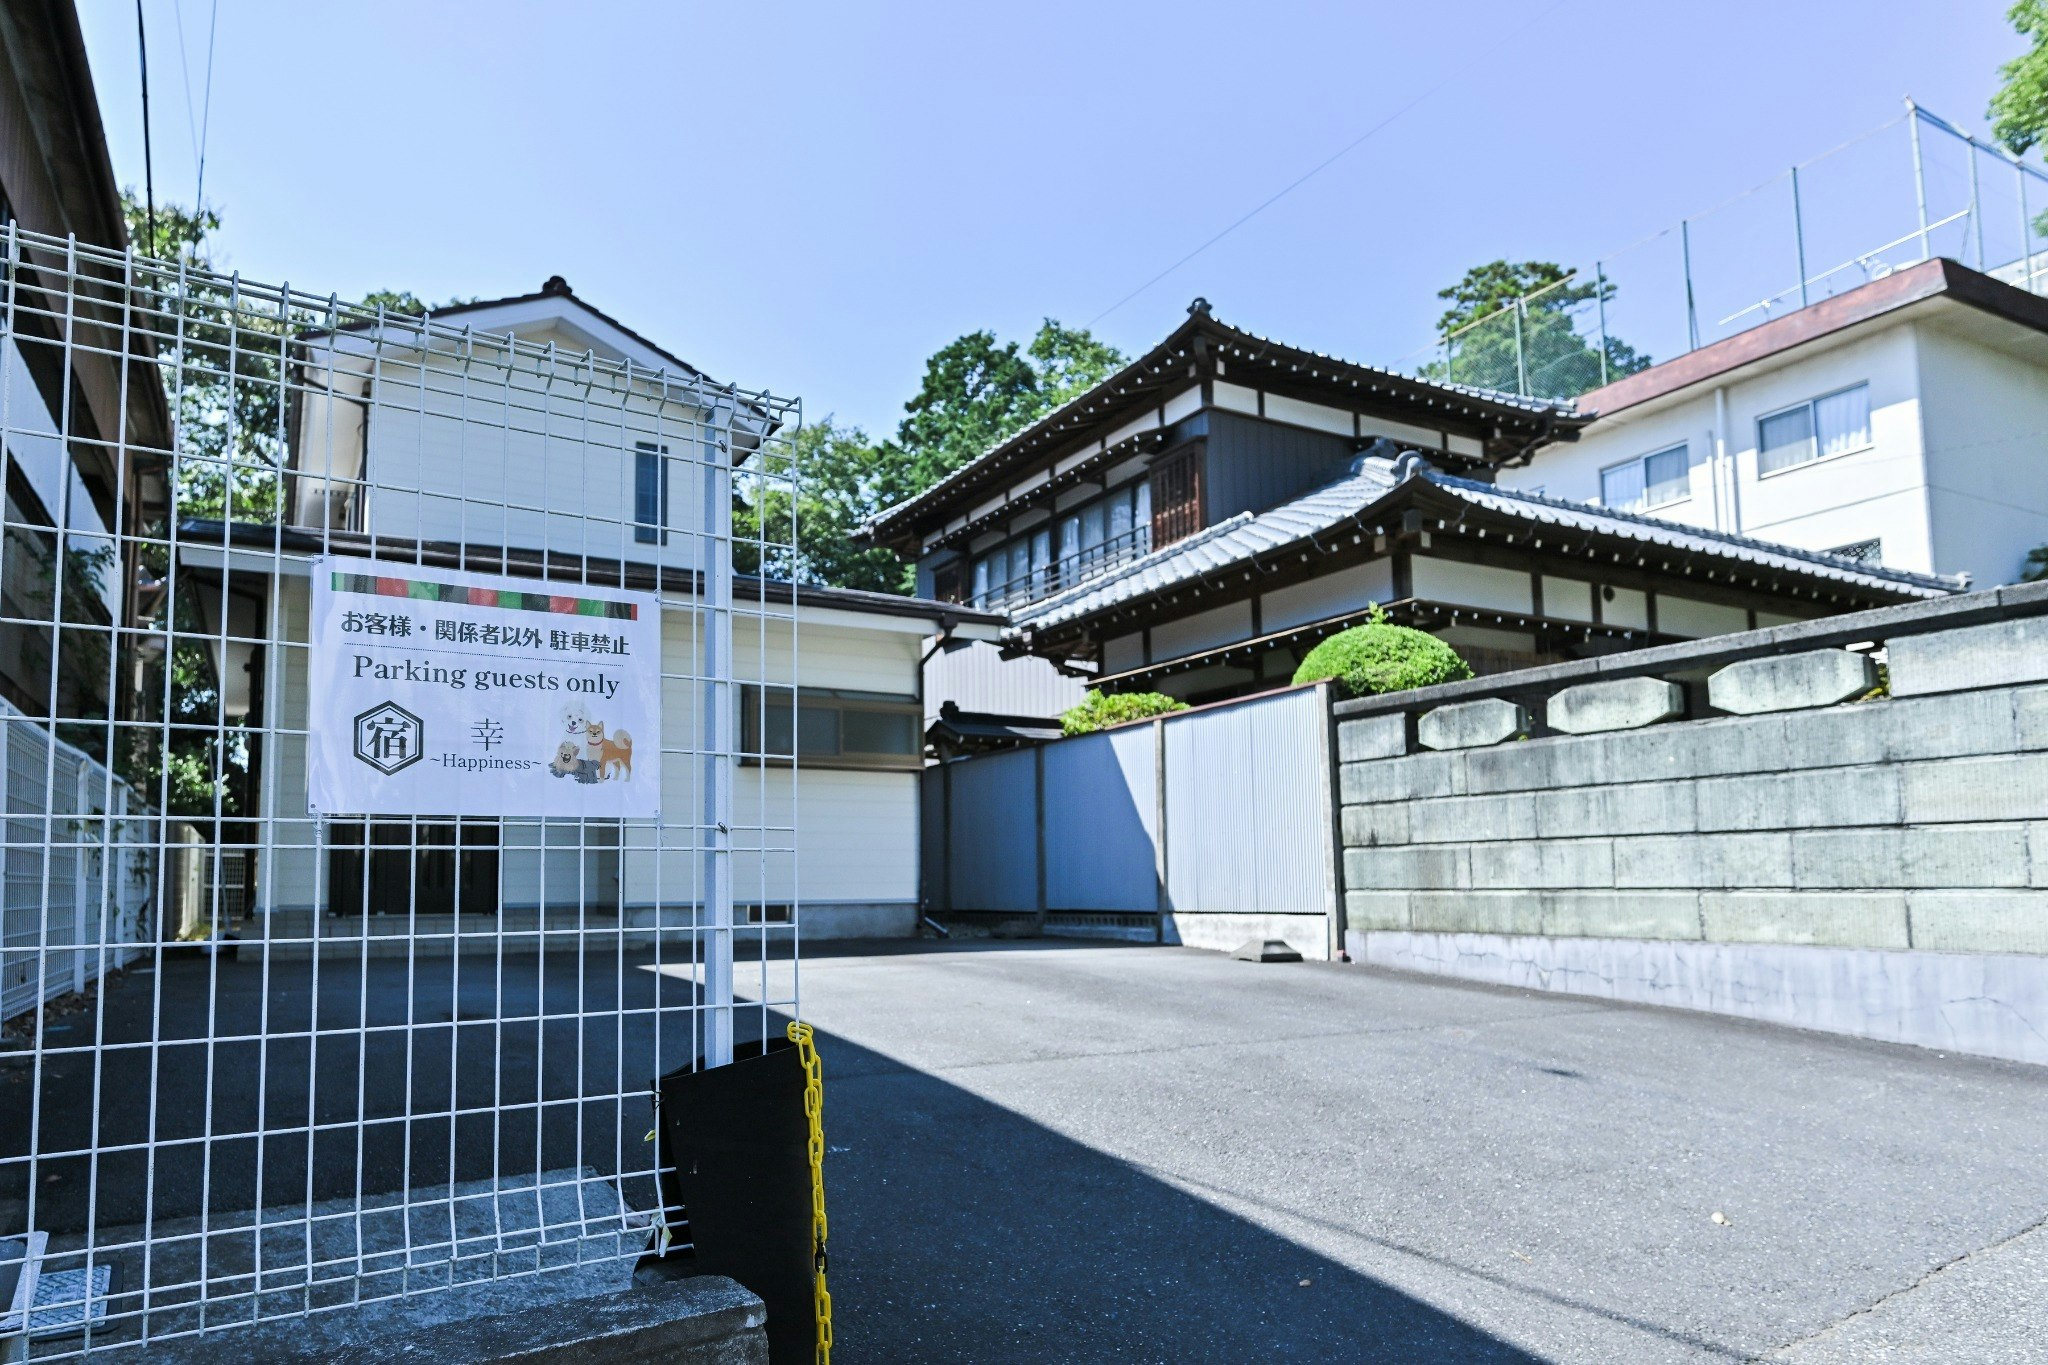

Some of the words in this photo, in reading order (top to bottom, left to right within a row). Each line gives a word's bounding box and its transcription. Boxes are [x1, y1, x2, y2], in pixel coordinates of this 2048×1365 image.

[341, 611, 543, 648] お客様・関係者以外
[549, 631, 630, 656] 駐車禁止
[353, 655, 466, 689] Parking
[475, 671, 559, 691] guests
[566, 674, 620, 700] only
[366, 717, 411, 759] 宿
[470, 718, 504, 751] 幸
